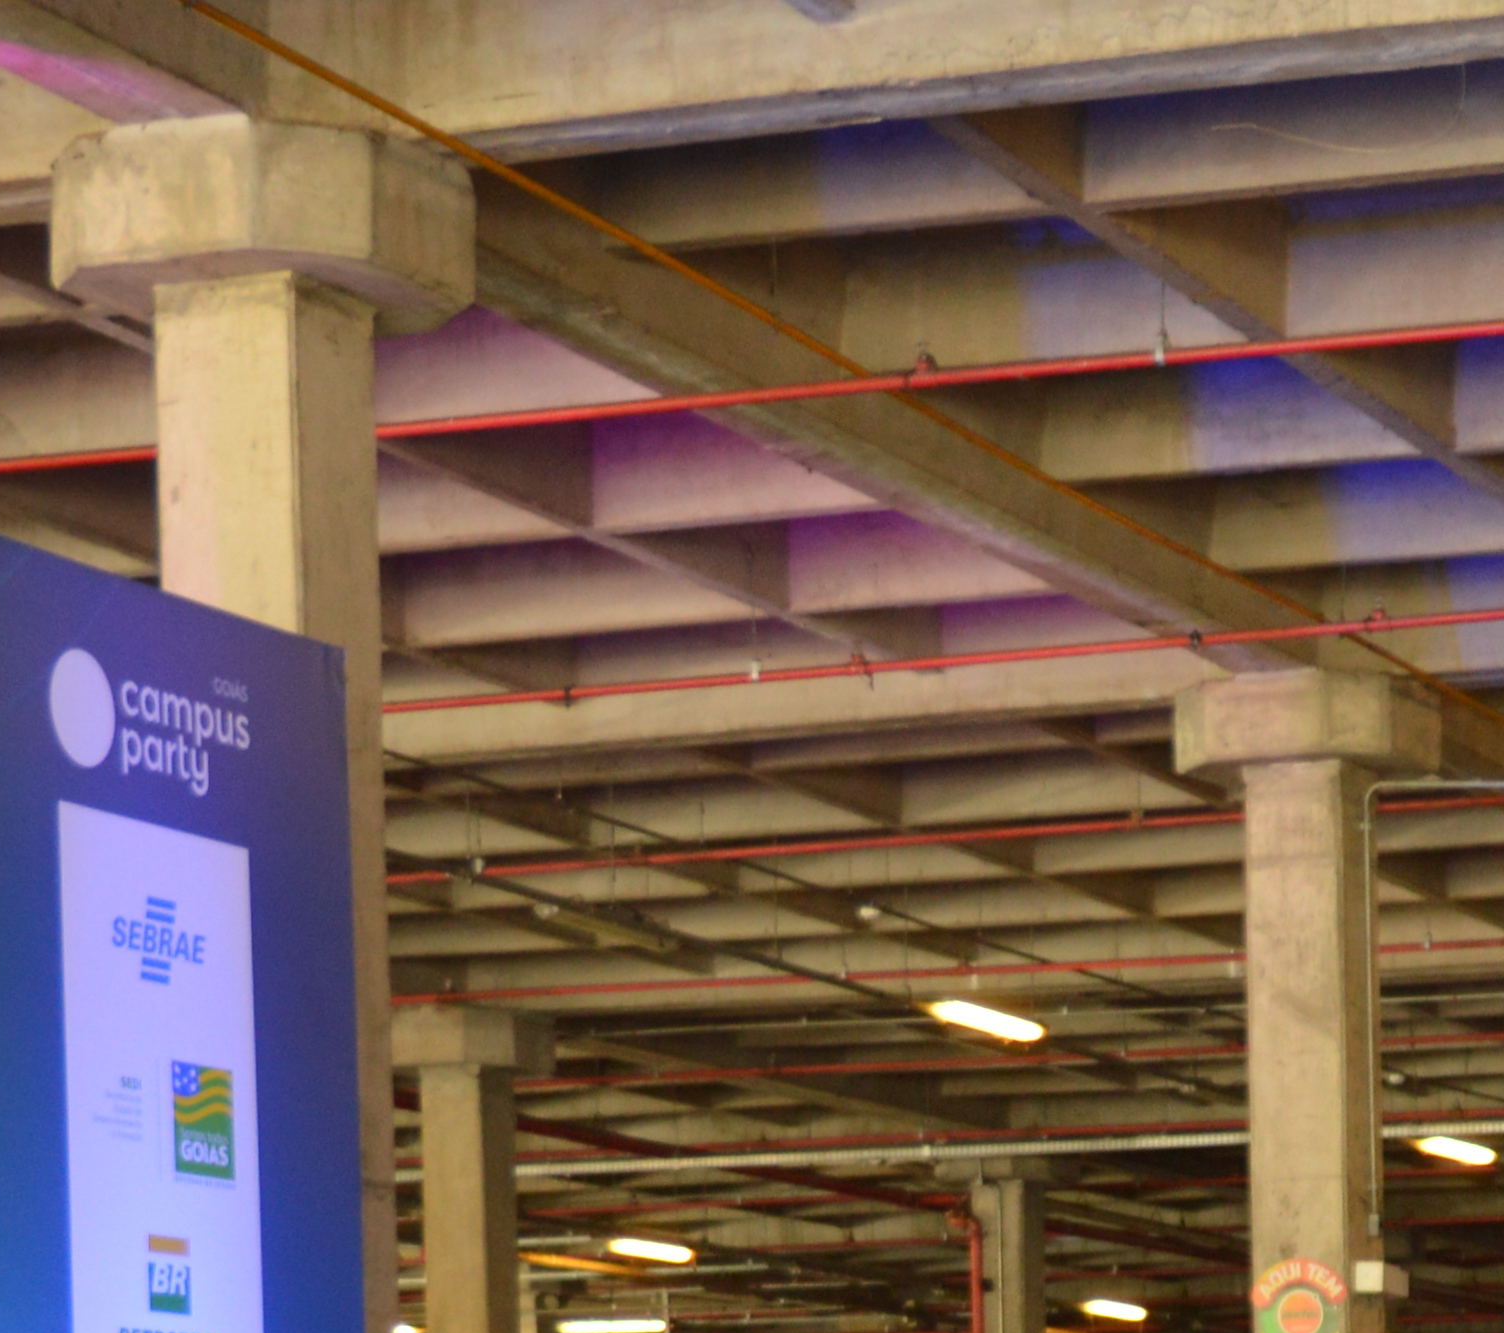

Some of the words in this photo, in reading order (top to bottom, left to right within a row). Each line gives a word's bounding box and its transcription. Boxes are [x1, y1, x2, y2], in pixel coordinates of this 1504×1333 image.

[120, 679, 251, 751] campus
[120, 726, 209, 797] party
[111, 917, 206, 966] SEBRAE
[152, 1262, 188, 1297] BR
[1259, 1262, 1302, 1301] AQUI
[1307, 1262, 1344, 1299] TEM
